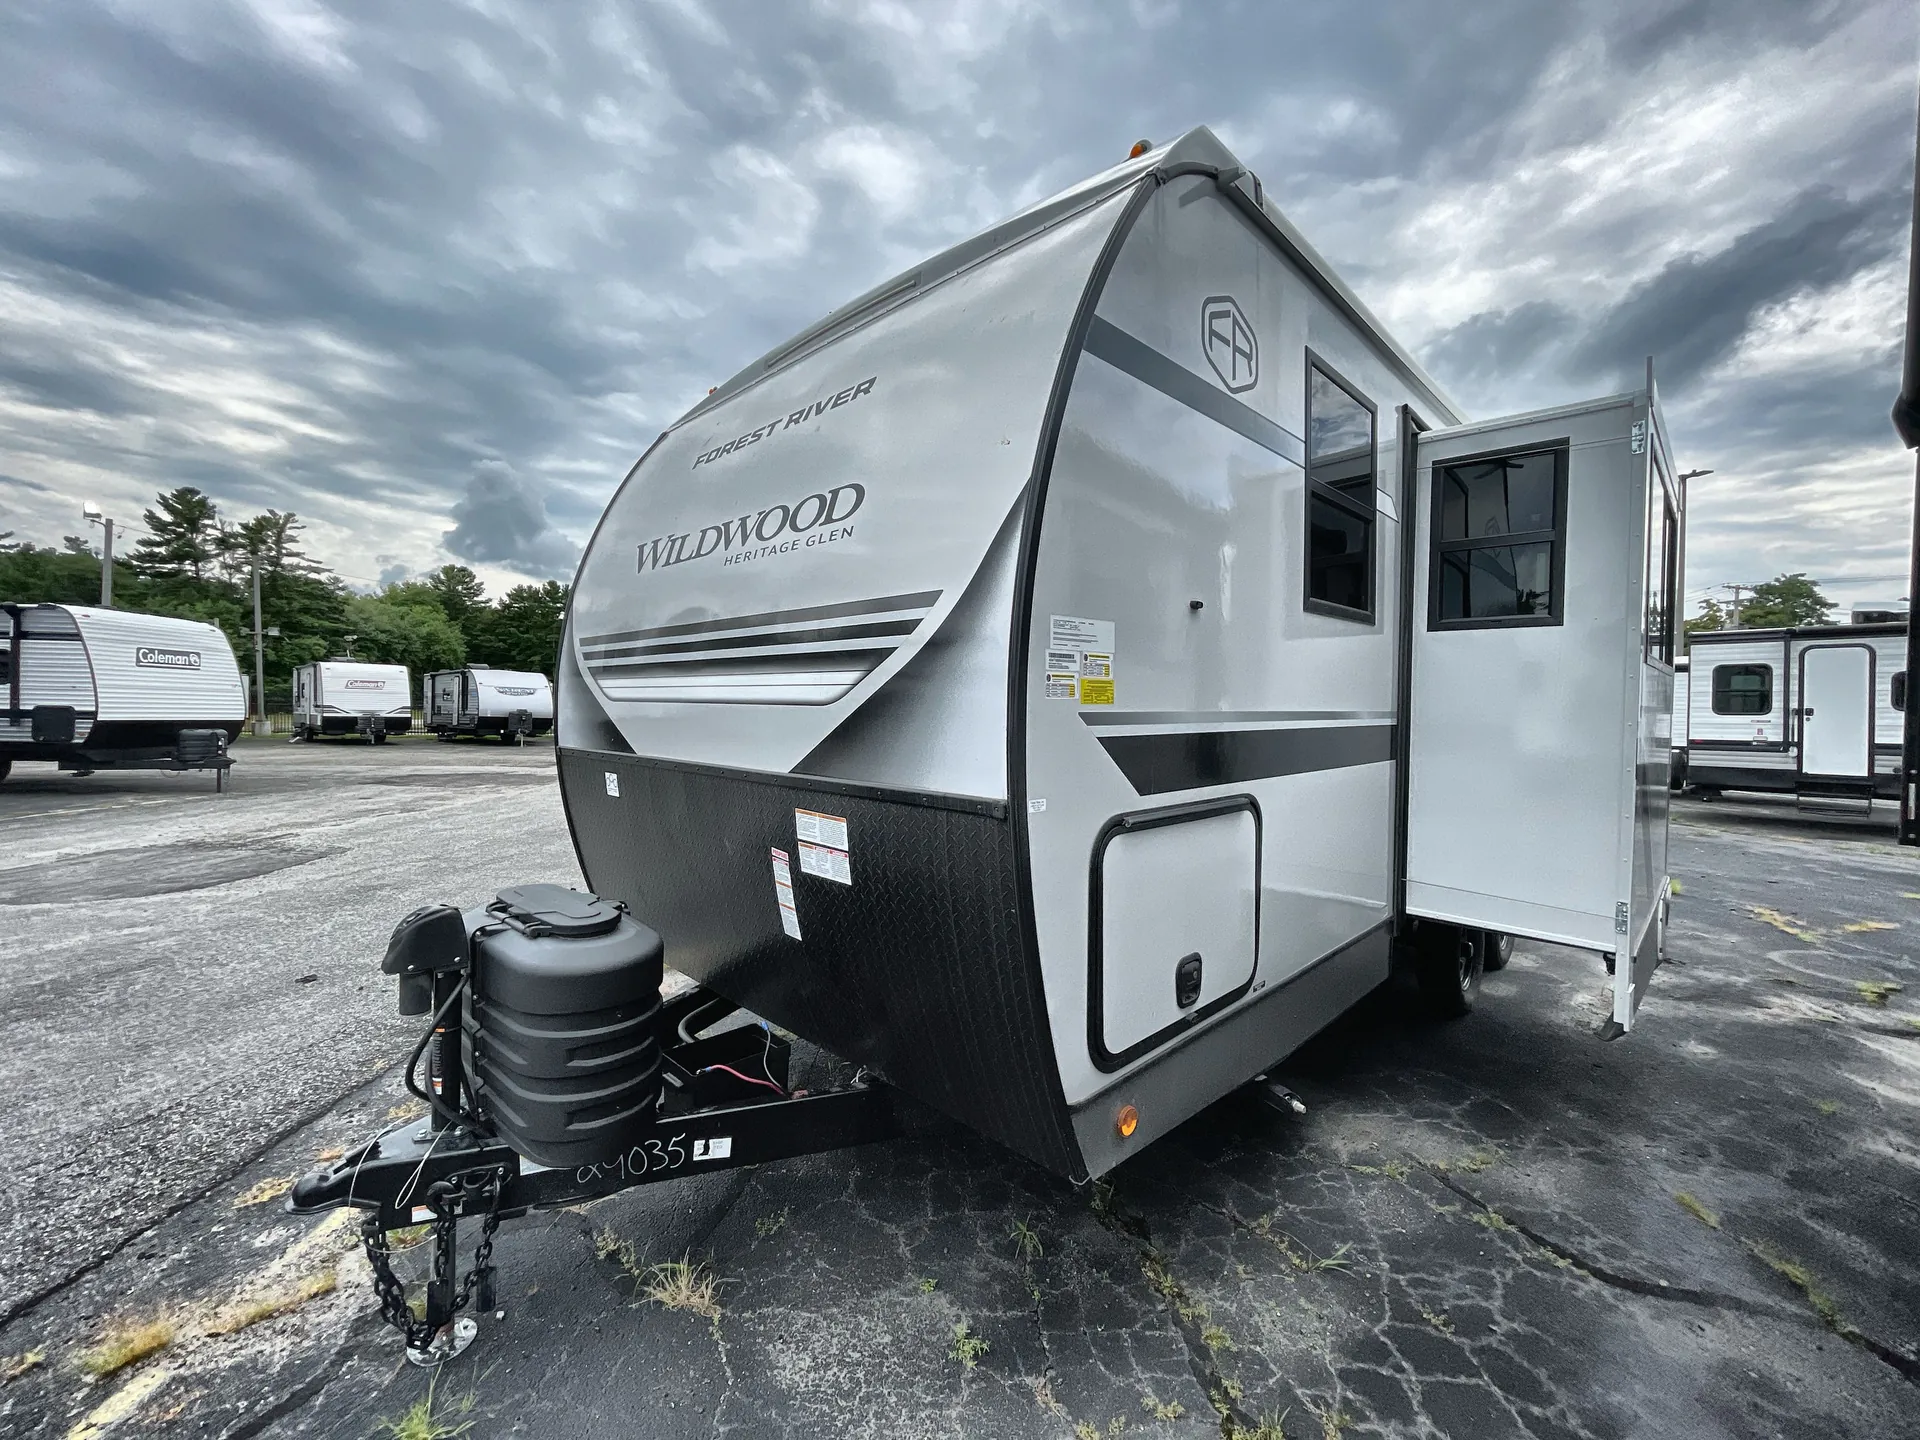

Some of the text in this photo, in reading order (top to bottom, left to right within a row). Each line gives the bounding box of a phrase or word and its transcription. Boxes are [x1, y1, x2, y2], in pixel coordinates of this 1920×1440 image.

[691, 376, 878, 470] FOREST RIVER
[636, 483, 866, 574] WILDWOOD
[723, 525, 855, 566] HERITAGE GLEN
[138, 649, 189, 665] Coleman
